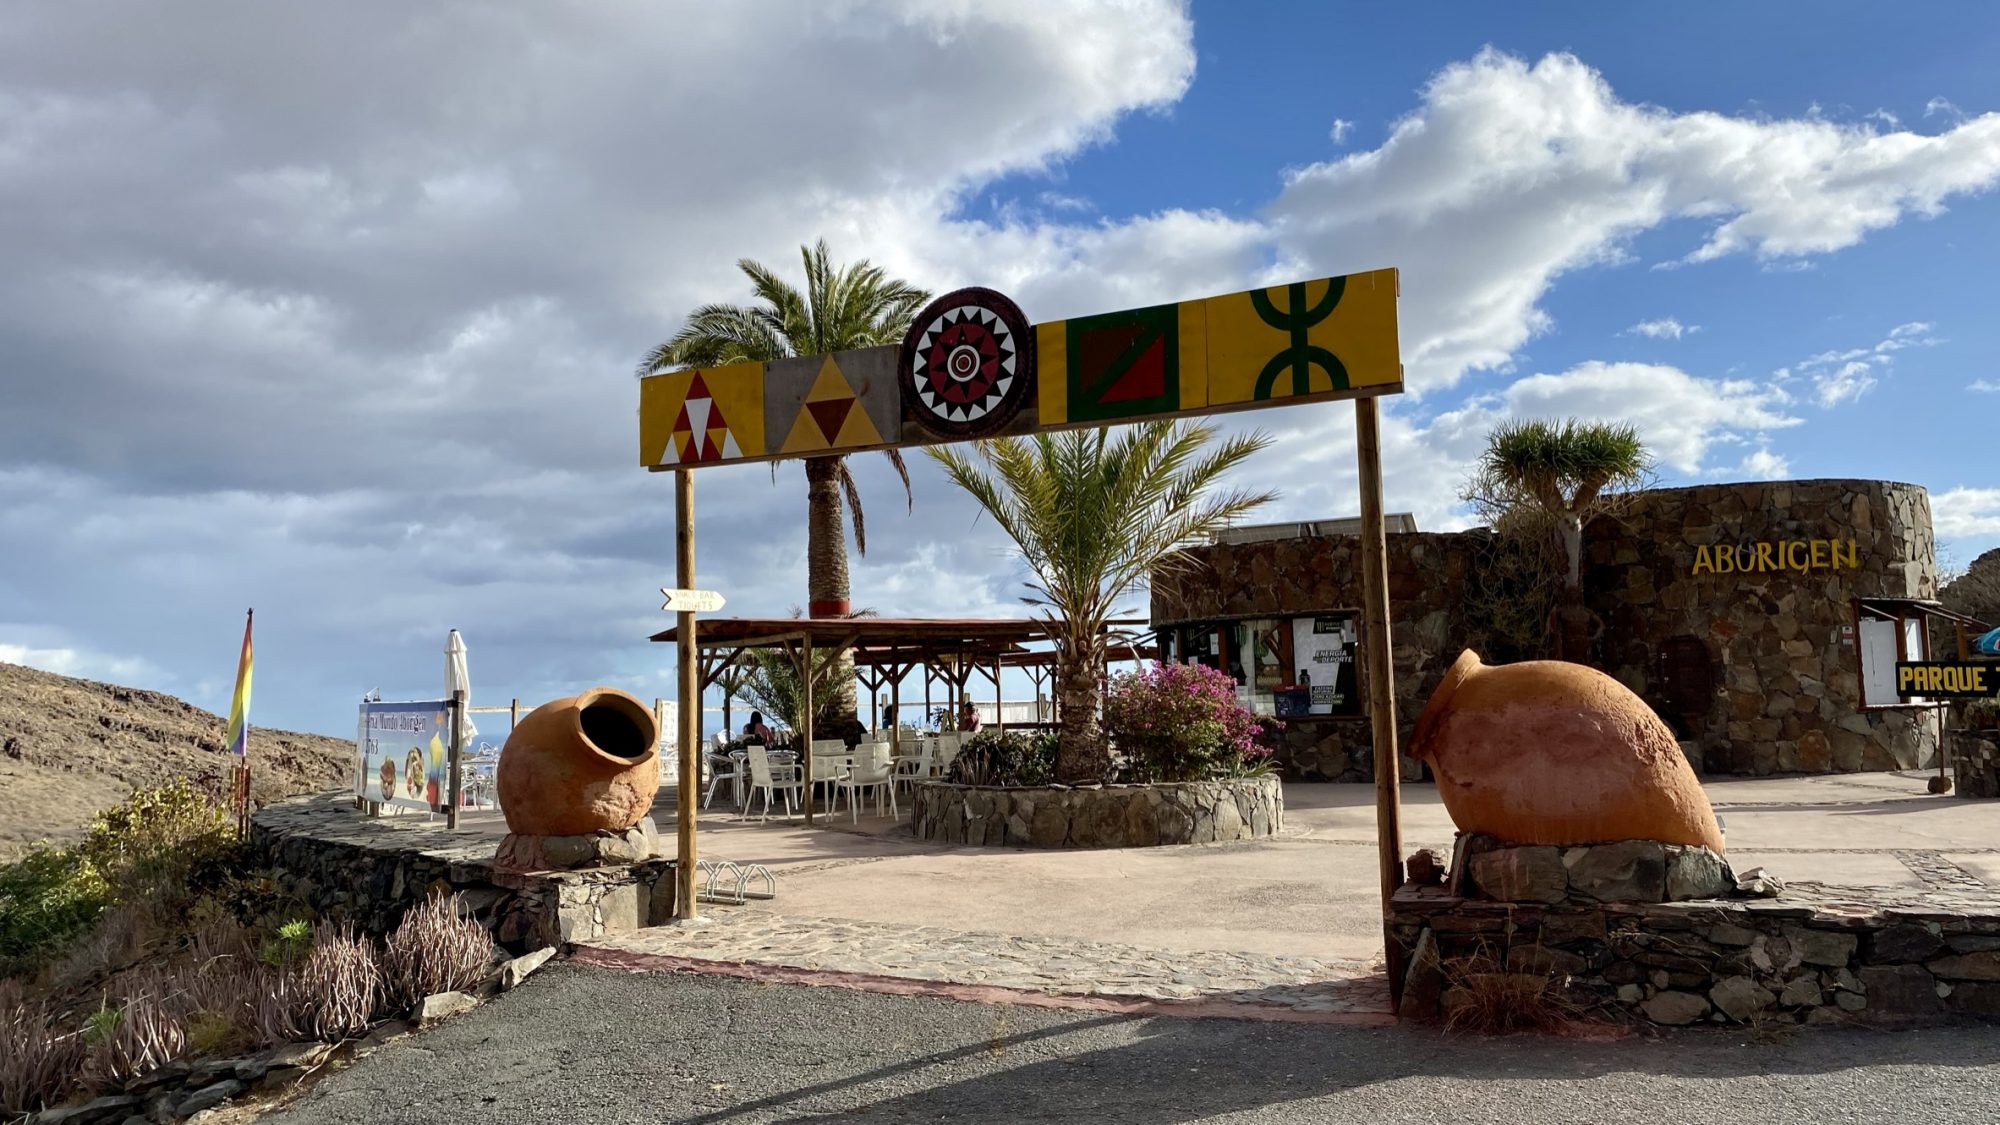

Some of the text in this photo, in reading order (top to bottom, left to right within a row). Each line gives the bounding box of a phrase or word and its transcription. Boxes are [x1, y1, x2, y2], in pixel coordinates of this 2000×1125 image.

[1691, 538, 1858, 576] ABORIGEN
[1899, 666, 1988, 693] PARQUE
[380, 712, 398, 730] Mundo
